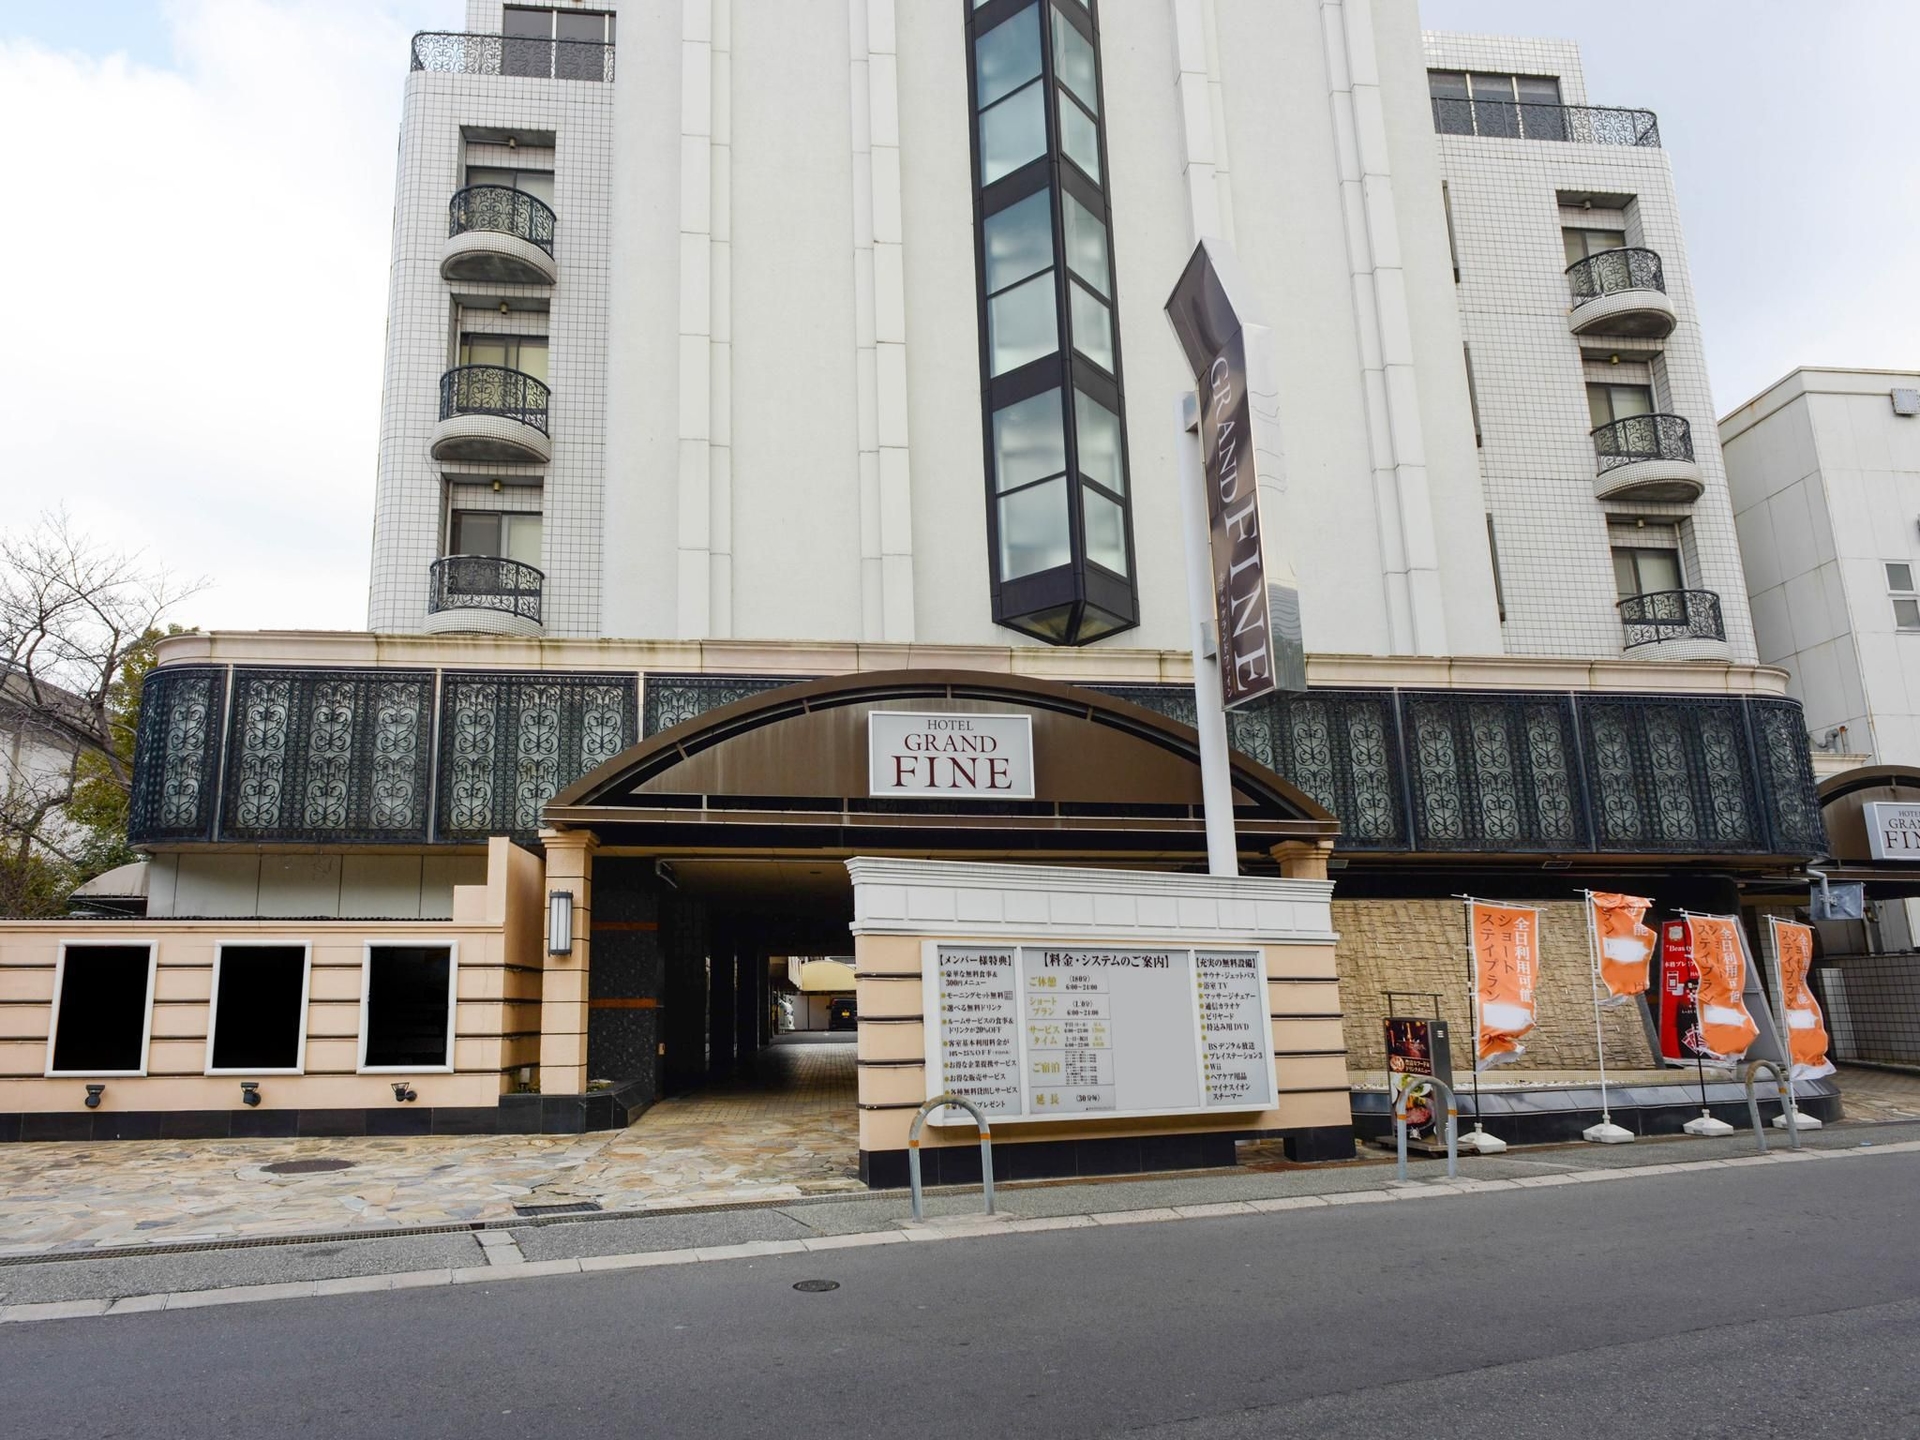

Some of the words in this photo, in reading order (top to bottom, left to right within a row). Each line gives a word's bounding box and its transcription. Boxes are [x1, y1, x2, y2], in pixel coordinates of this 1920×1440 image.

[1211, 357, 1238, 503] GRAND
[1224, 500, 1270, 691] FINE
[927, 720, 974, 731] HOTEL
[904, 734, 997, 753] GRAND
[891, 755, 1013, 790] FINE
[1888, 818, 1920, 829] GRA
[1498, 914, 1514, 974] ショート
[940, 954, 1012, 967] 【メンバー様特典】
[1044, 952, 1169, 968] 【料金・システムのご案内】
[1196, 957, 1256, 968] 【充実の無料設備】
[1480, 913, 1500, 1002] ステイプラン
[1029, 976, 1057, 988] ご休憩
[947, 991, 1004, 999] モーニングセット無料
[1029, 996, 1057, 1006] ショート
[1205, 1002, 1240, 1010] 通信カラオケ
[947, 1004, 1002, 1012] 選べる無料ドリンク
[1033, 1007, 1054, 1016] プラン
[1029, 1024, 1060, 1034] サービス
[1034, 1036, 1058, 1045] タイム
[1209, 1052, 1263, 1060] プレイステーション3
[1210, 1072, 1247, 1080] ヘアケア用品
[951, 1087, 1018, 1096] 各種無料貸出しサービス
[1211, 1084, 1251, 1092] マイナスイオン
[1213, 1093, 1243, 1101] スチーマー
